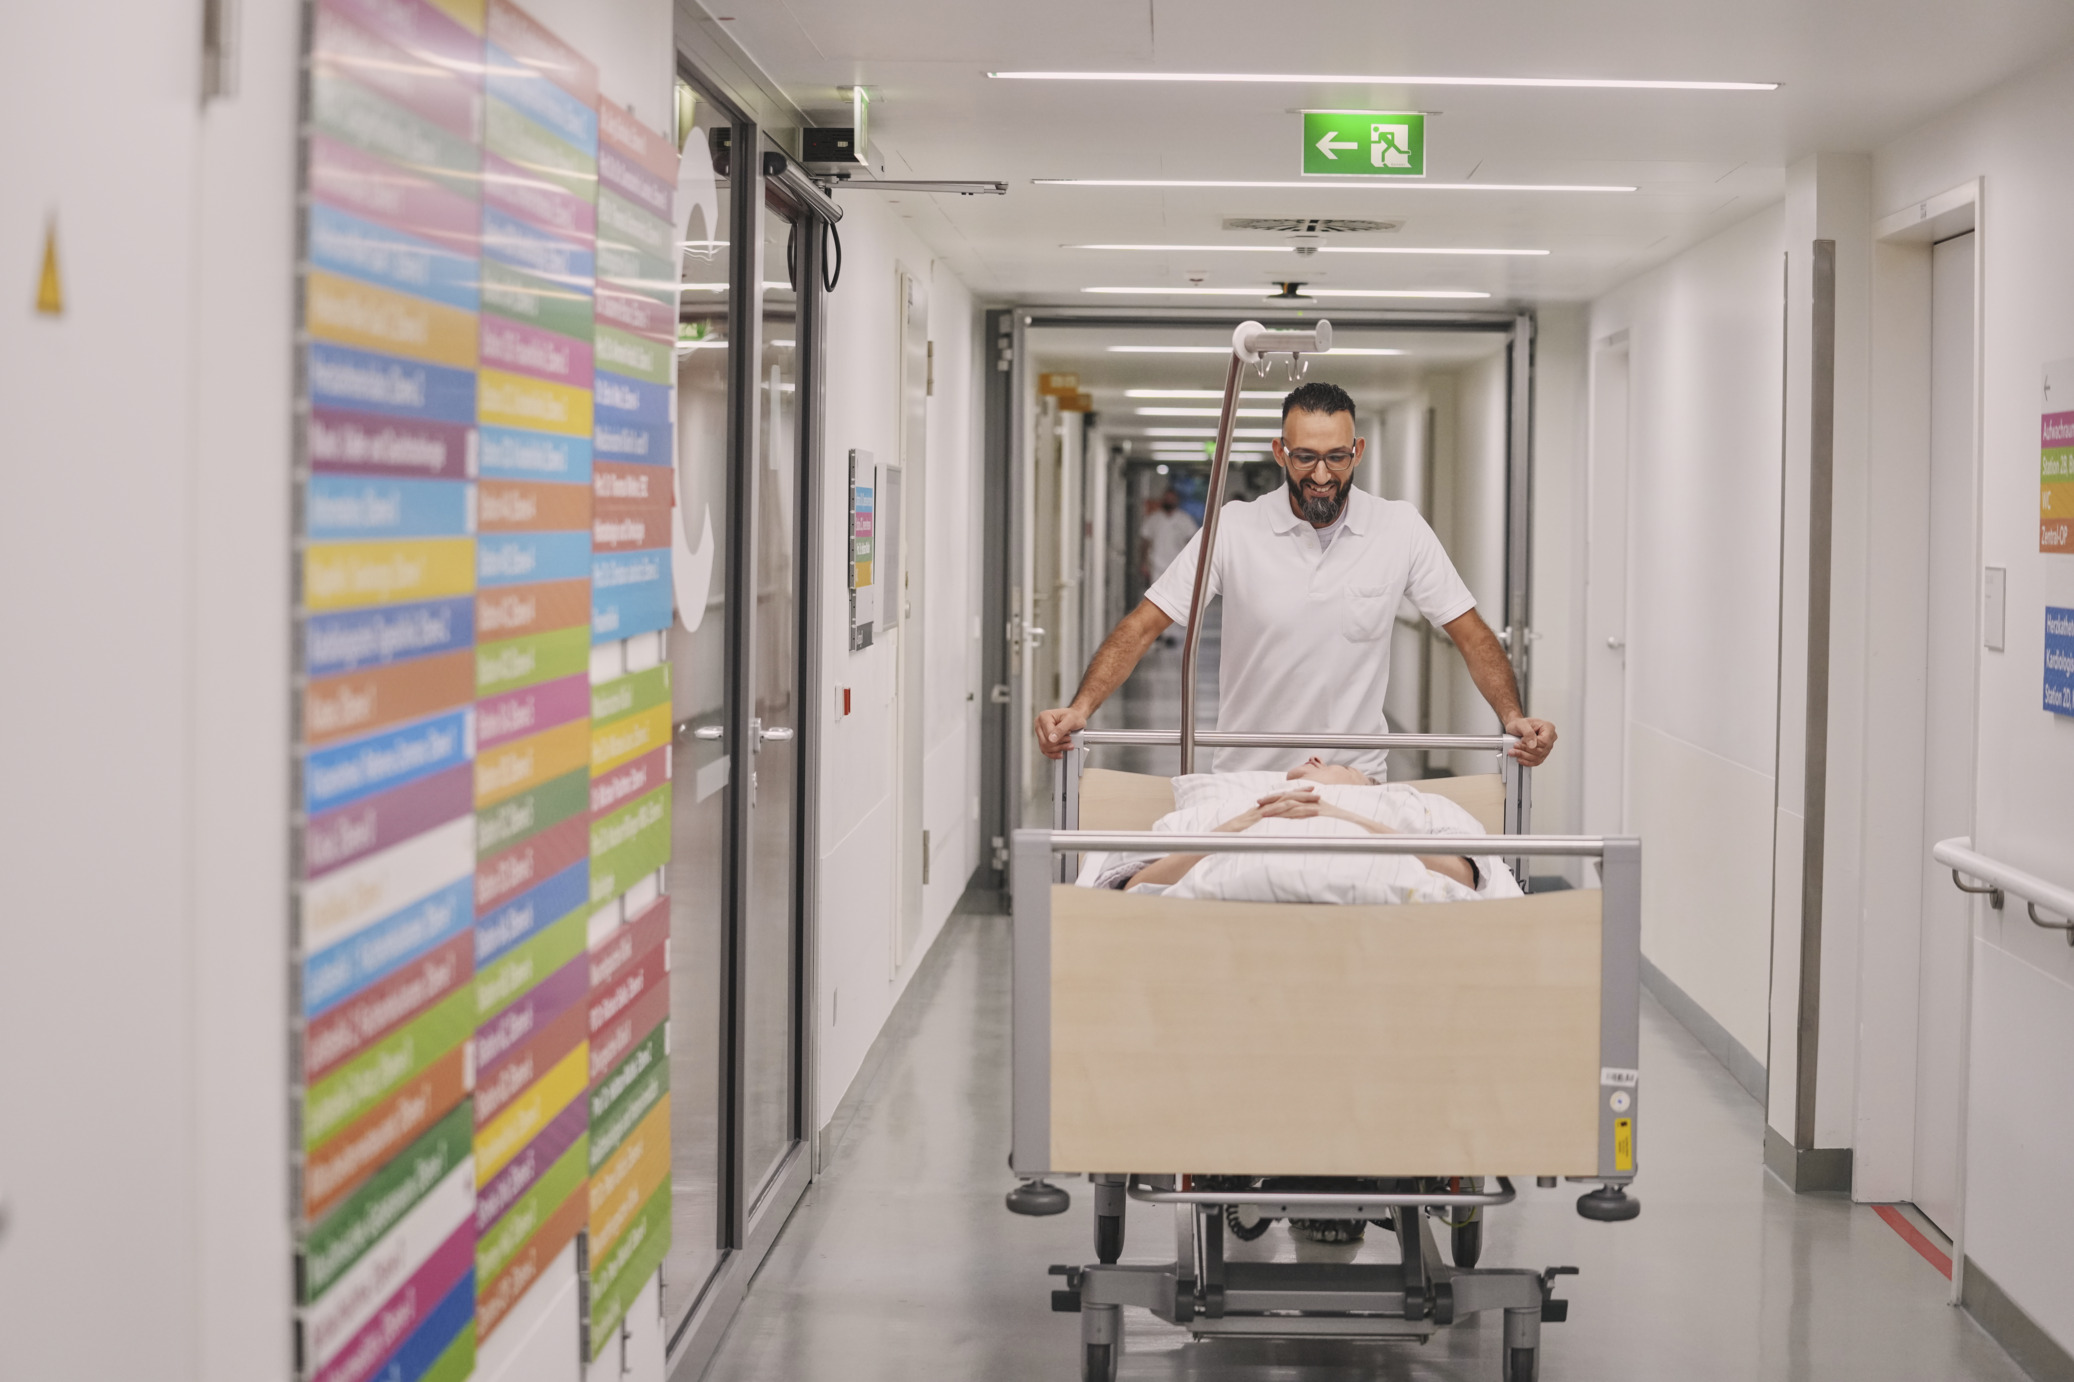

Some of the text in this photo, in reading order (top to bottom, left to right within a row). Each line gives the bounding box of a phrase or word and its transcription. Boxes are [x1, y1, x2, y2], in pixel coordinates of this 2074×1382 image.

[2043, 456, 2059, 475] Station
[2042, 490, 2051, 510] WC
[2041, 524, 2068, 545] Zentral-OP
[2045, 683, 2062, 705] Station
